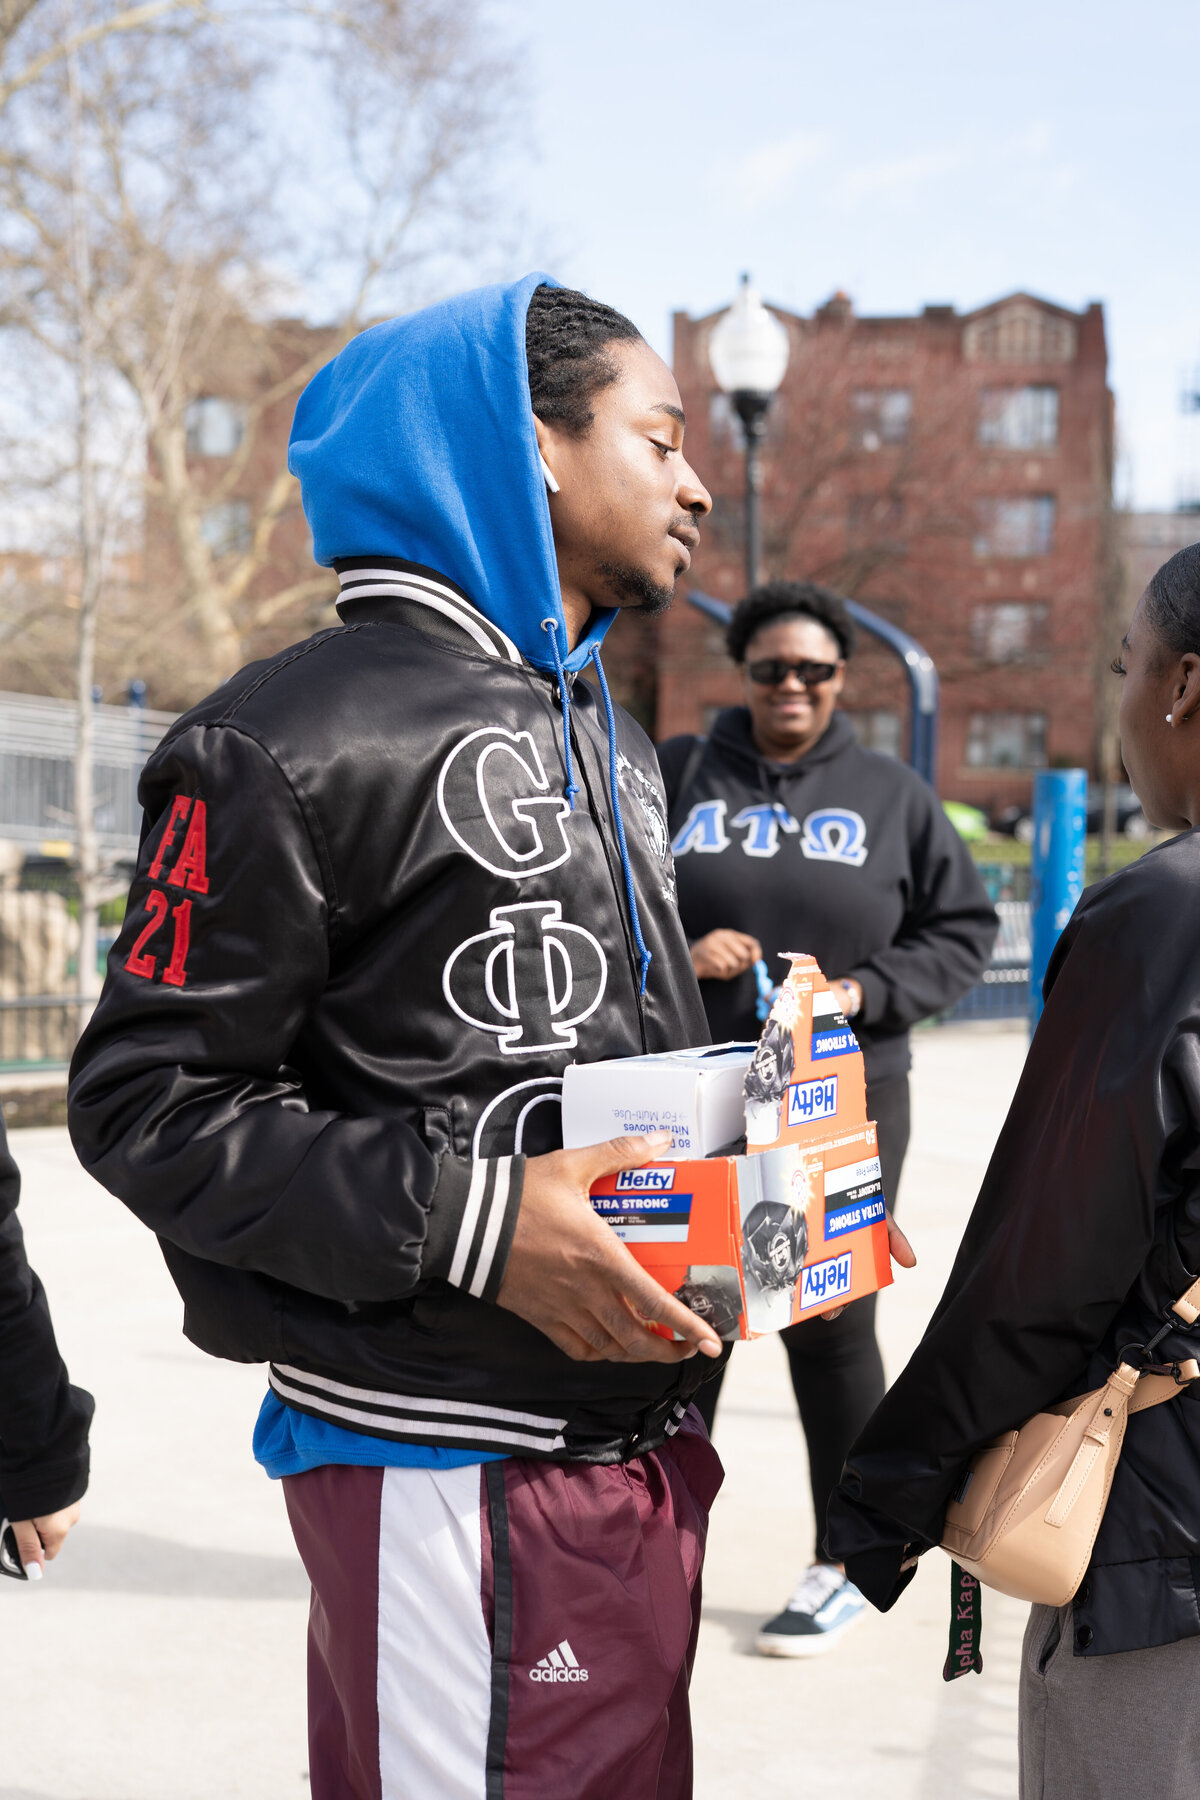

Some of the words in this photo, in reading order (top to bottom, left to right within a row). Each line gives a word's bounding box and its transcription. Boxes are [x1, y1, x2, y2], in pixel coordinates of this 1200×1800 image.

[147, 794, 210, 895] FA
[124, 889, 193, 987] 21
[815, 1034, 847, 1053] STRONG
[791, 1083, 835, 1116] Hefty
[661, 1111, 677, 1122] For
[623, 1123, 657, 1134] Gloves
[678, 1138, 691, 1149] 80
[619, 1171, 670, 1190] Hefty
[591, 1199, 620, 1209] LTRA
[622, 1198, 669, 1209] STRONG
[861, 1201, 884, 1221] ULTRA
[829, 1209, 861, 1232] STRONG
[804, 1259, 849, 1297] Hefty
[957, 1566, 978, 1621] Kap
[955, 1628, 975, 1677] lpha
[528, 1666, 589, 1683] adidas
